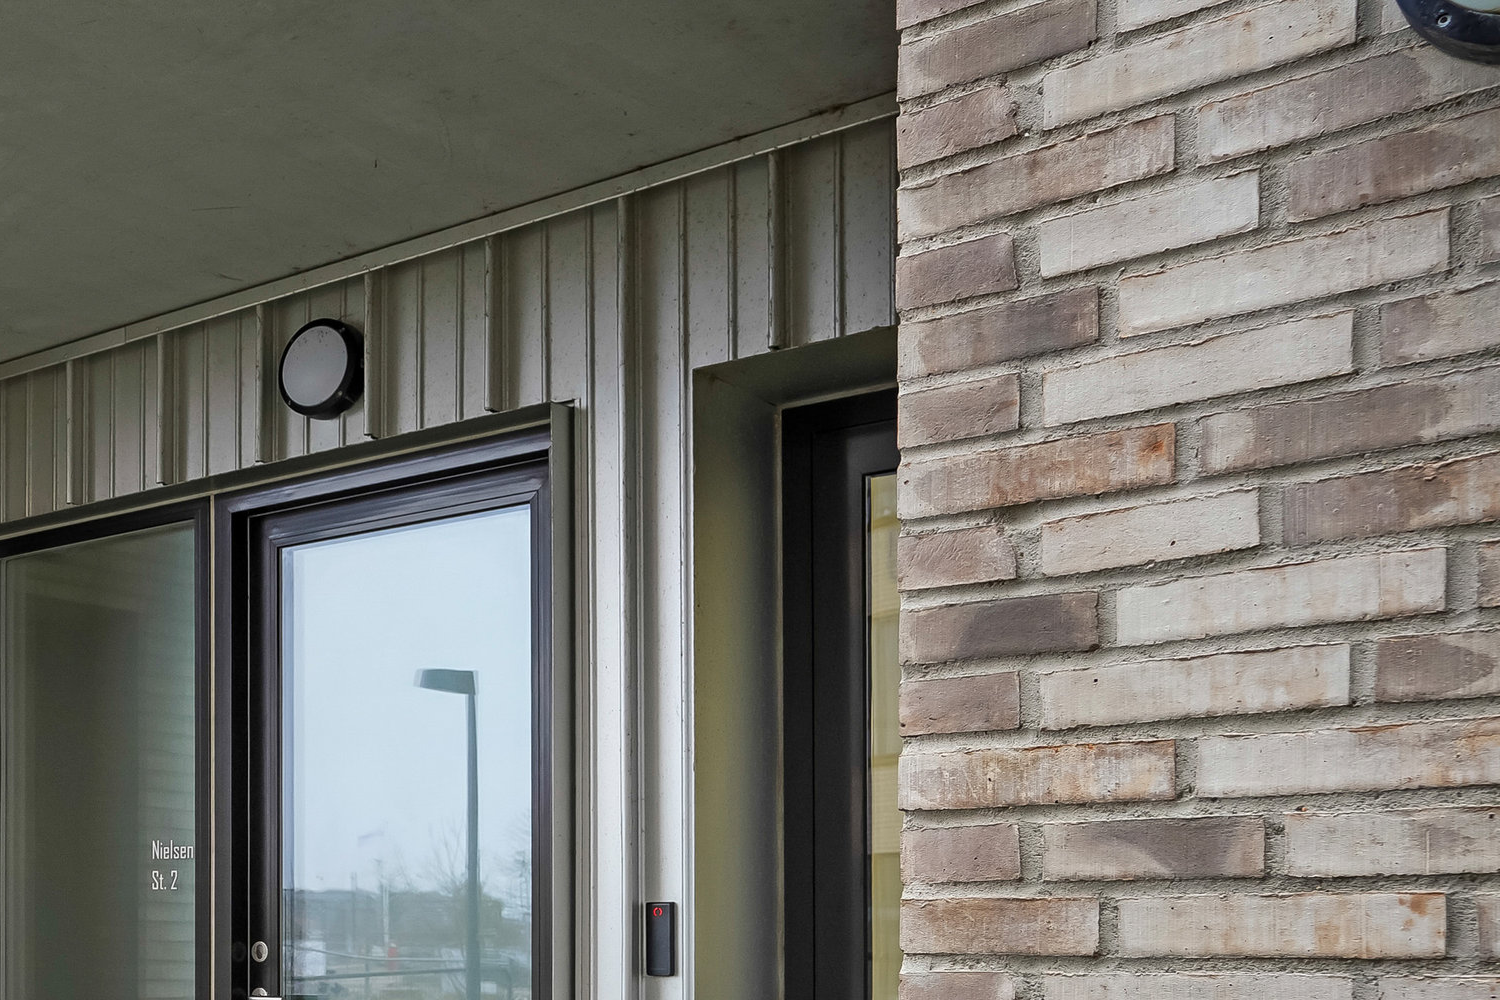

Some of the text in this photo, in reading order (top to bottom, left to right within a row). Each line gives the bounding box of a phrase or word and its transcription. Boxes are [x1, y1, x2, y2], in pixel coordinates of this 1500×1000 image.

[152, 839, 194, 860] Nielsen
[152, 870, 178, 890] St. 2
